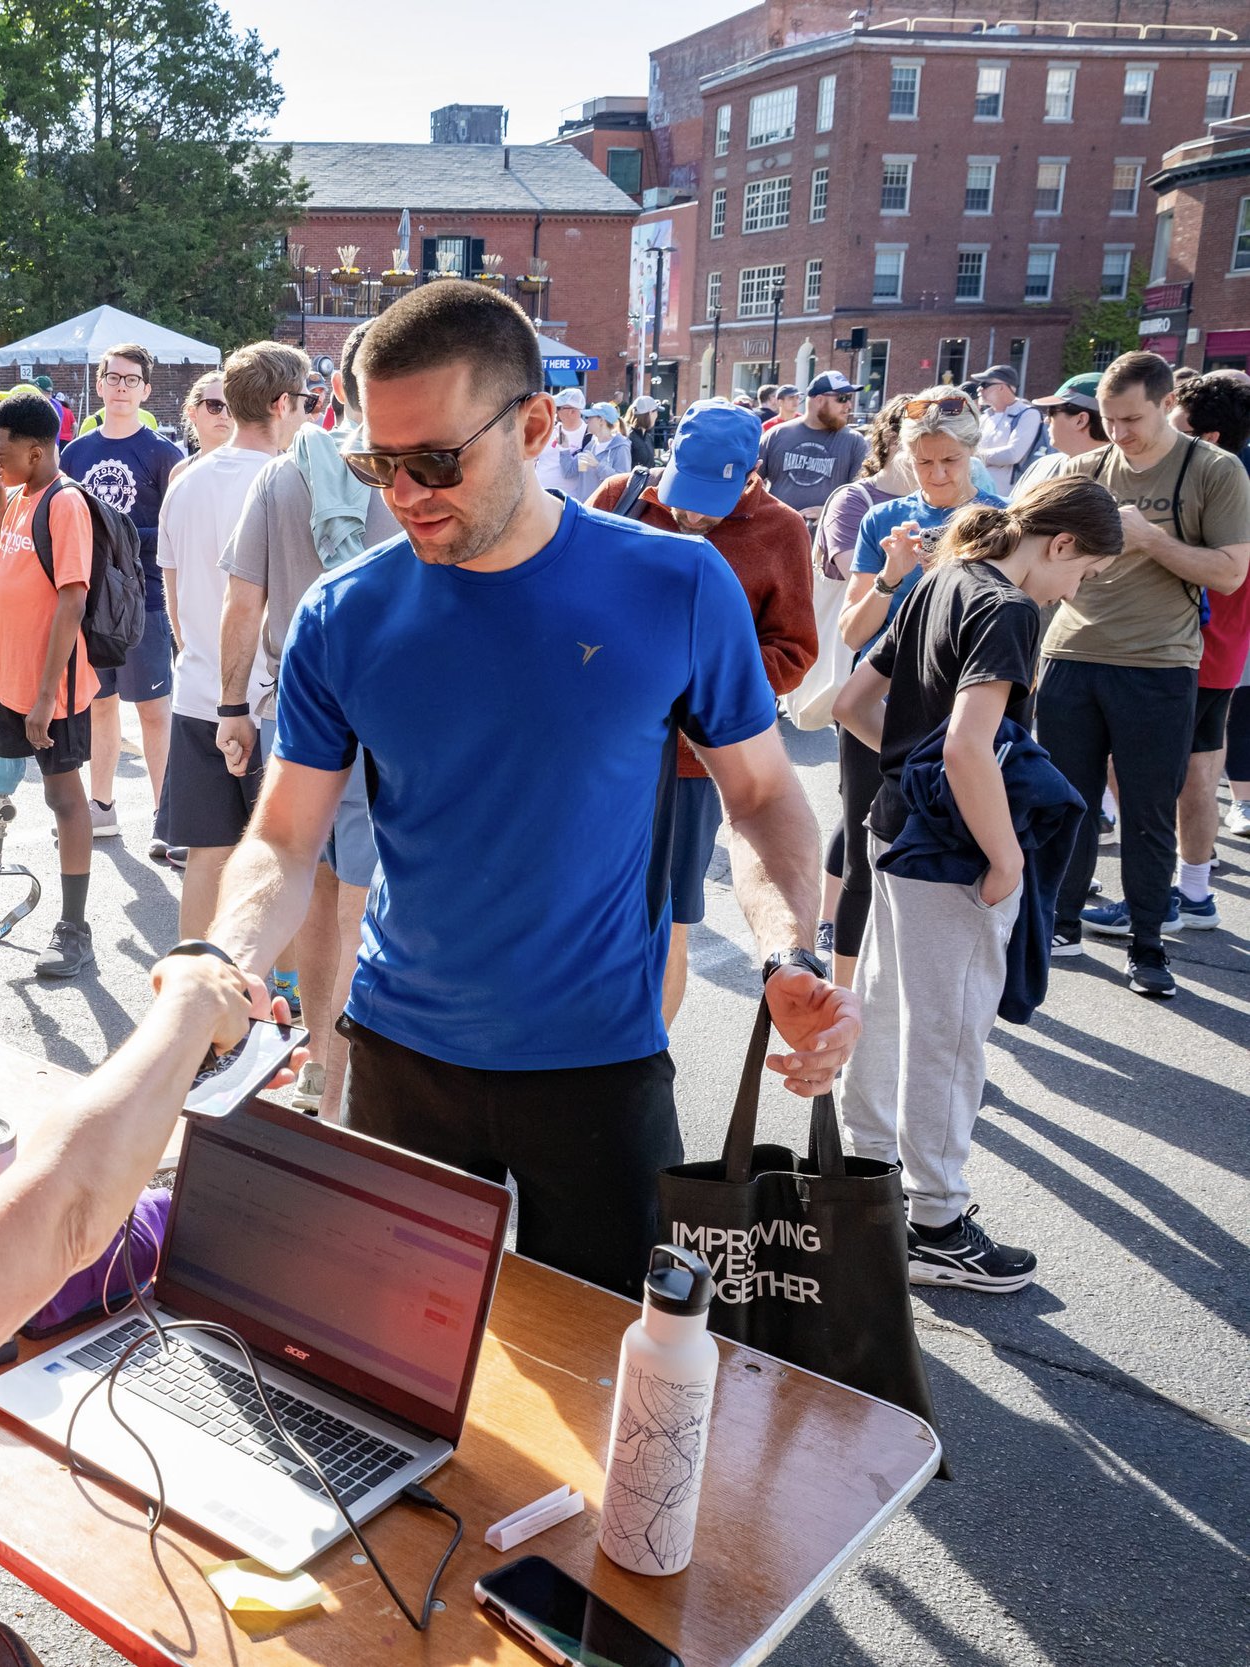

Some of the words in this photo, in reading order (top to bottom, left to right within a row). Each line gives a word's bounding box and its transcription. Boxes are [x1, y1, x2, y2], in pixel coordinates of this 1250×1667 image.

[21, 368, 31, 377] 32
[549, 360, 570, 369] HERE
[95, 467, 123, 478] POLAR
[672, 1219, 822, 1254] IMPROVING
[672, 1249, 756, 1279] LVES
[709, 1270, 823, 1304] GETHER
[284, 1344, 310, 1360] acer
